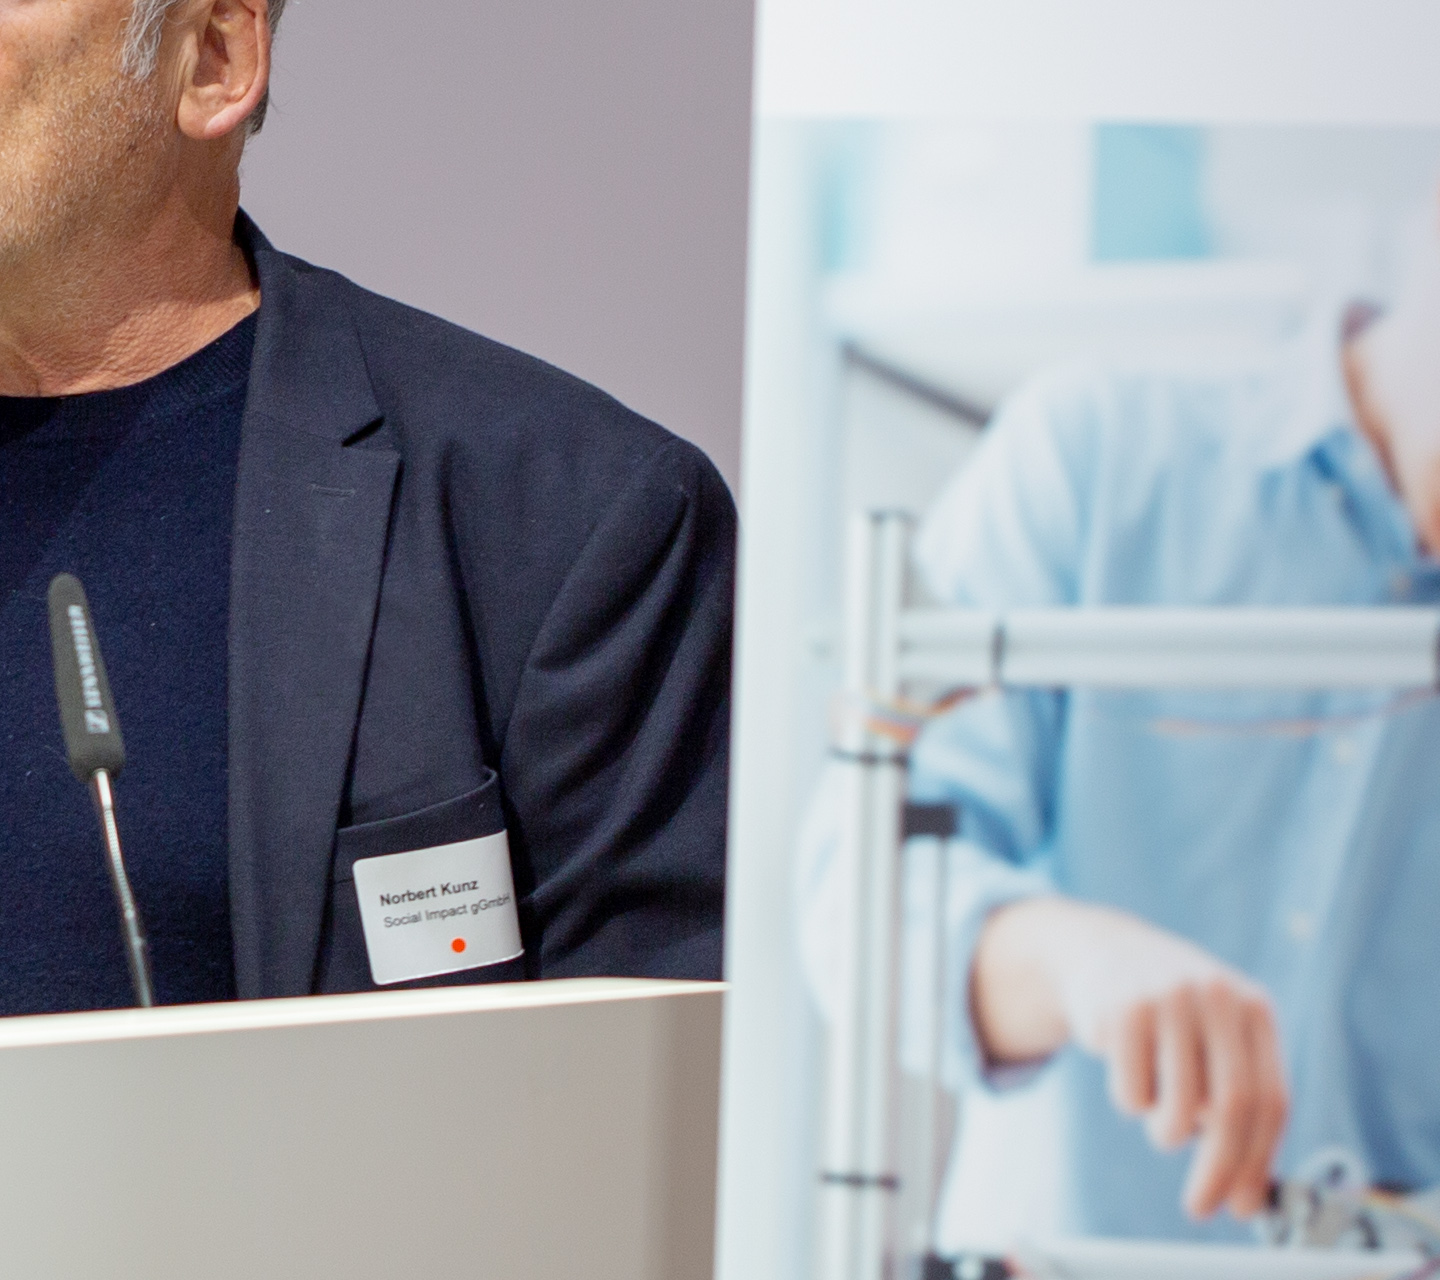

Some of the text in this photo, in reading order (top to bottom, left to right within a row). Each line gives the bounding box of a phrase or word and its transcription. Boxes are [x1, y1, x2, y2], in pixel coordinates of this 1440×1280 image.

[380, 880, 479, 906] Norbert Kunz
[384, 911, 422, 928] Social
[425, 904, 468, 920] Impact
